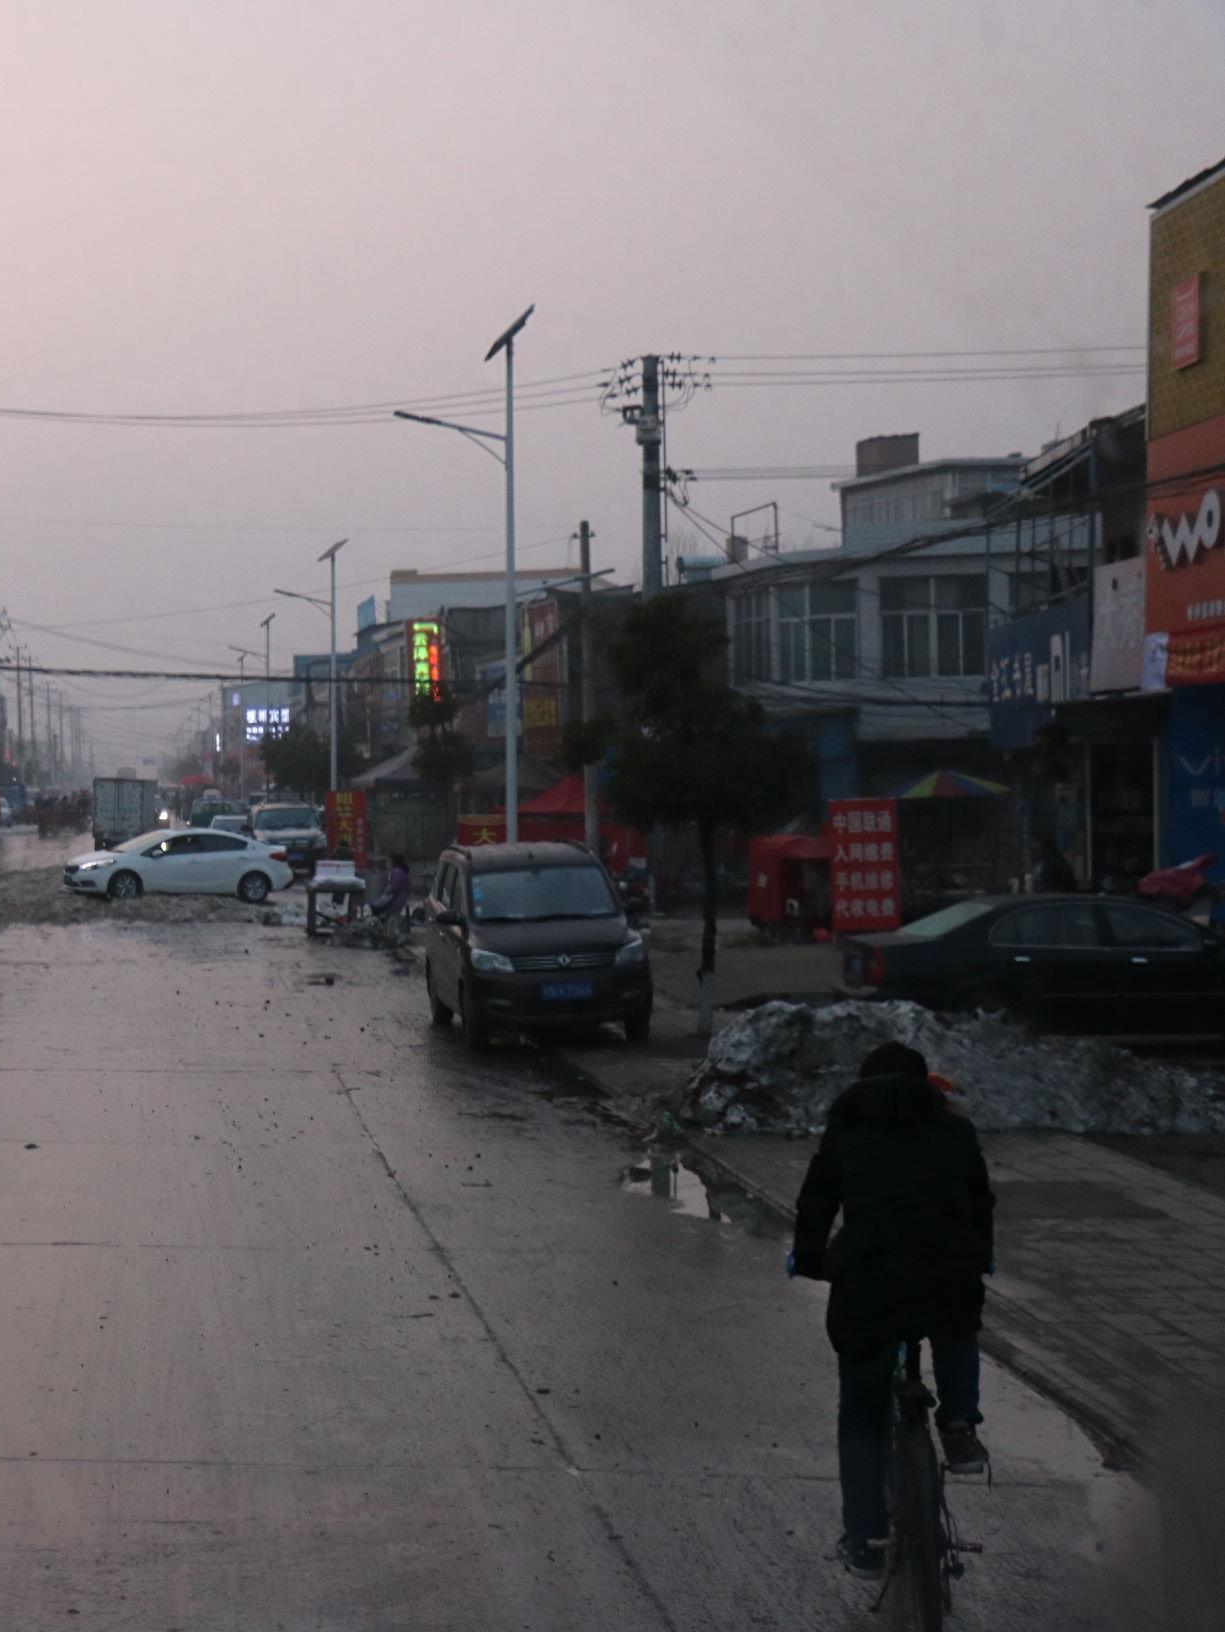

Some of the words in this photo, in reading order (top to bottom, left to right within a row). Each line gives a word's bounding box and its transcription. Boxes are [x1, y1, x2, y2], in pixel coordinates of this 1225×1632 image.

[1177, 743, 1225, 777] vi
[832, 811, 892, 835] 中国联通
[835, 869, 895, 892] 手机维修
[835, 897, 896, 918] 代收电费
